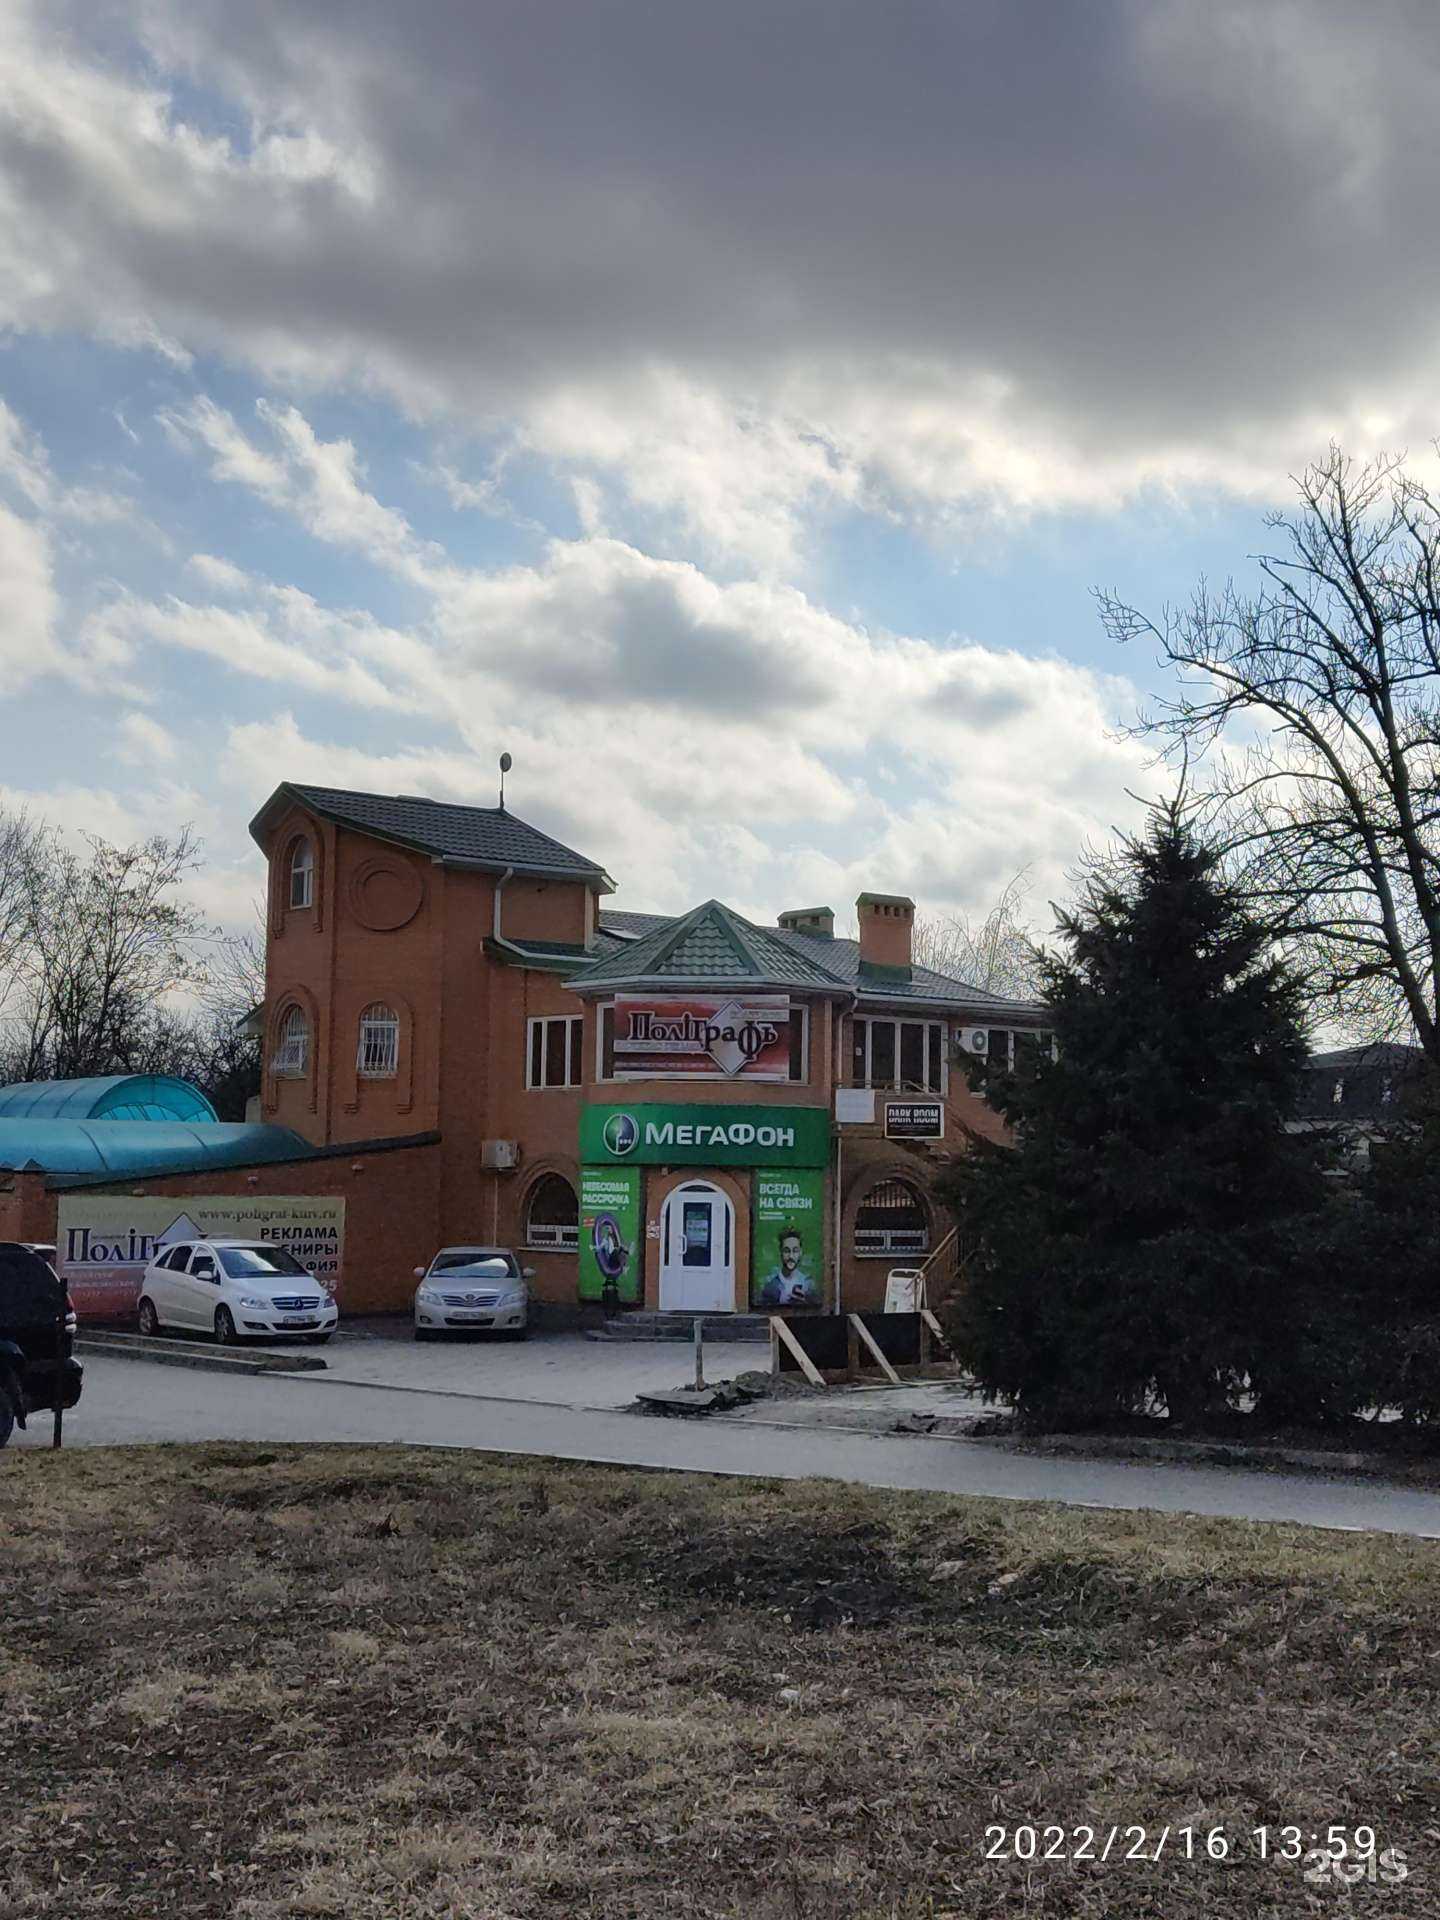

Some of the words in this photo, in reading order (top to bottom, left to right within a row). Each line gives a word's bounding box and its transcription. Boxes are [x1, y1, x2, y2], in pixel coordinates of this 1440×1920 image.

[645, 1122, 795, 1147] МЕГАФОН
[759, 1183, 800, 1196] ВСЕГДА
[759, 1197, 774, 1209] НА
[260, 1227, 338, 1240] РЕКЛАМА
